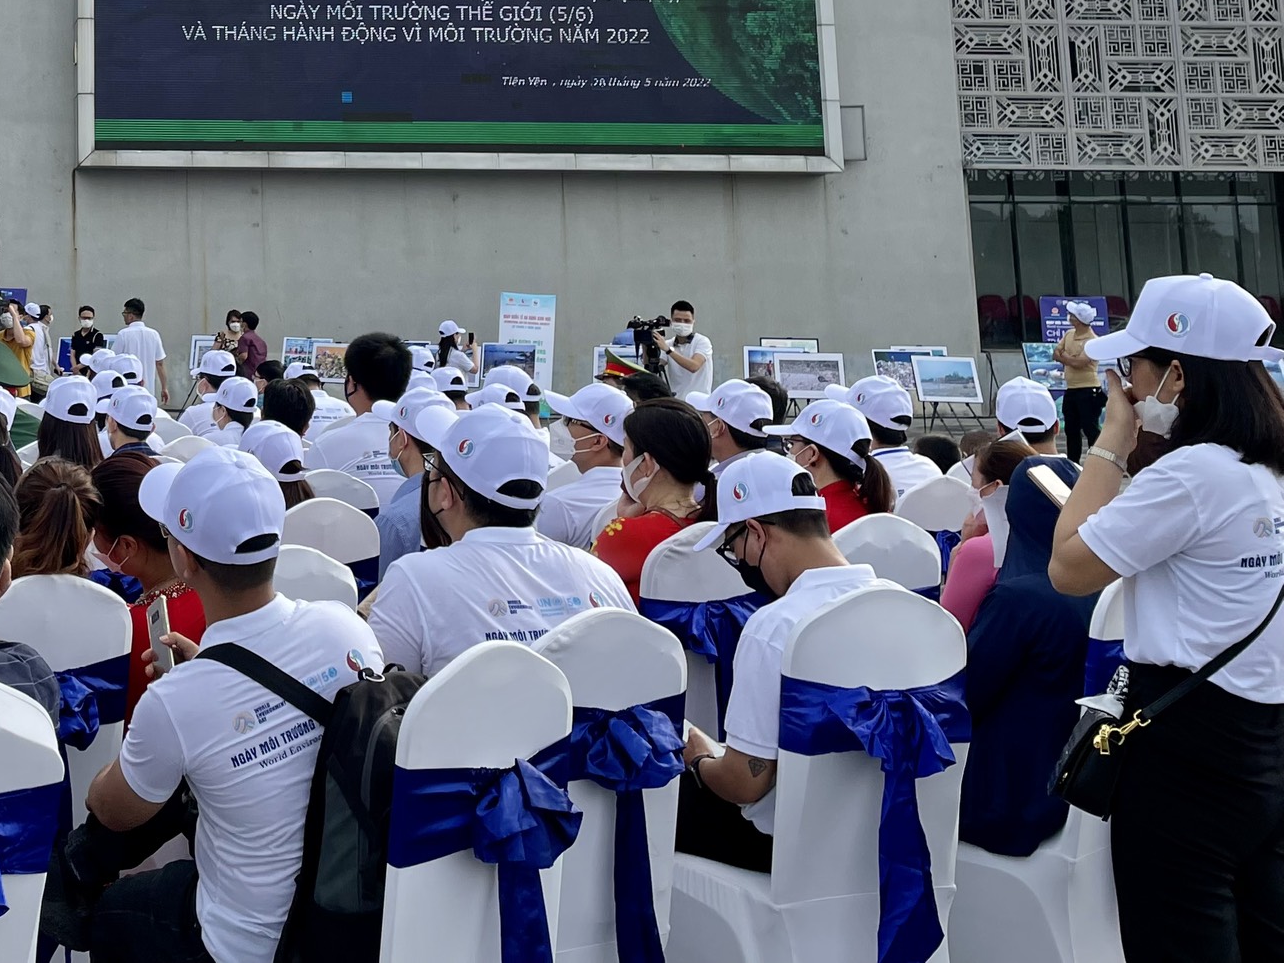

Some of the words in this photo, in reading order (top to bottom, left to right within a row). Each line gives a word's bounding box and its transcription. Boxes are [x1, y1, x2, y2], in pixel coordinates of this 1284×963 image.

[270, 0, 320, 20] NGÀY
[327, 0, 363, 20] MÔI
[369, 0, 451, 21] TRƯỜNG
[456, 1, 494, 21] THẾ
[500, 2, 543, 22] GIỚI
[549, 6, 594, 24] (5/6)
[181, 21, 207, 41] VÀ
[212, 21, 277, 41] THÁNG
[283, 21, 335, 41] HÀNH
[341, 22, 396, 44] ĐỘNG
[402, 22, 422, 42] VÌ
[429, 22, 466, 43] MÔI
[471, 24, 553, 43] TRƯỜNG
[559, 24, 599, 43] NĂM
[607, 28, 651, 44] 2022
[560, 75, 588, 89] ngày
[609, 75, 640, 89] tháng
[644, 77, 651, 87] 5
[654, 76, 680, 87] năm
[682, 77, 712, 88] 2022
[1240, 553, 1267, 568] NGÀY
[230, 748, 258, 768] NGÀY
[259, 734, 280, 756] MÔI
[280, 718, 316, 745] TRƯỜNG
[258, 752, 288, 769] World
